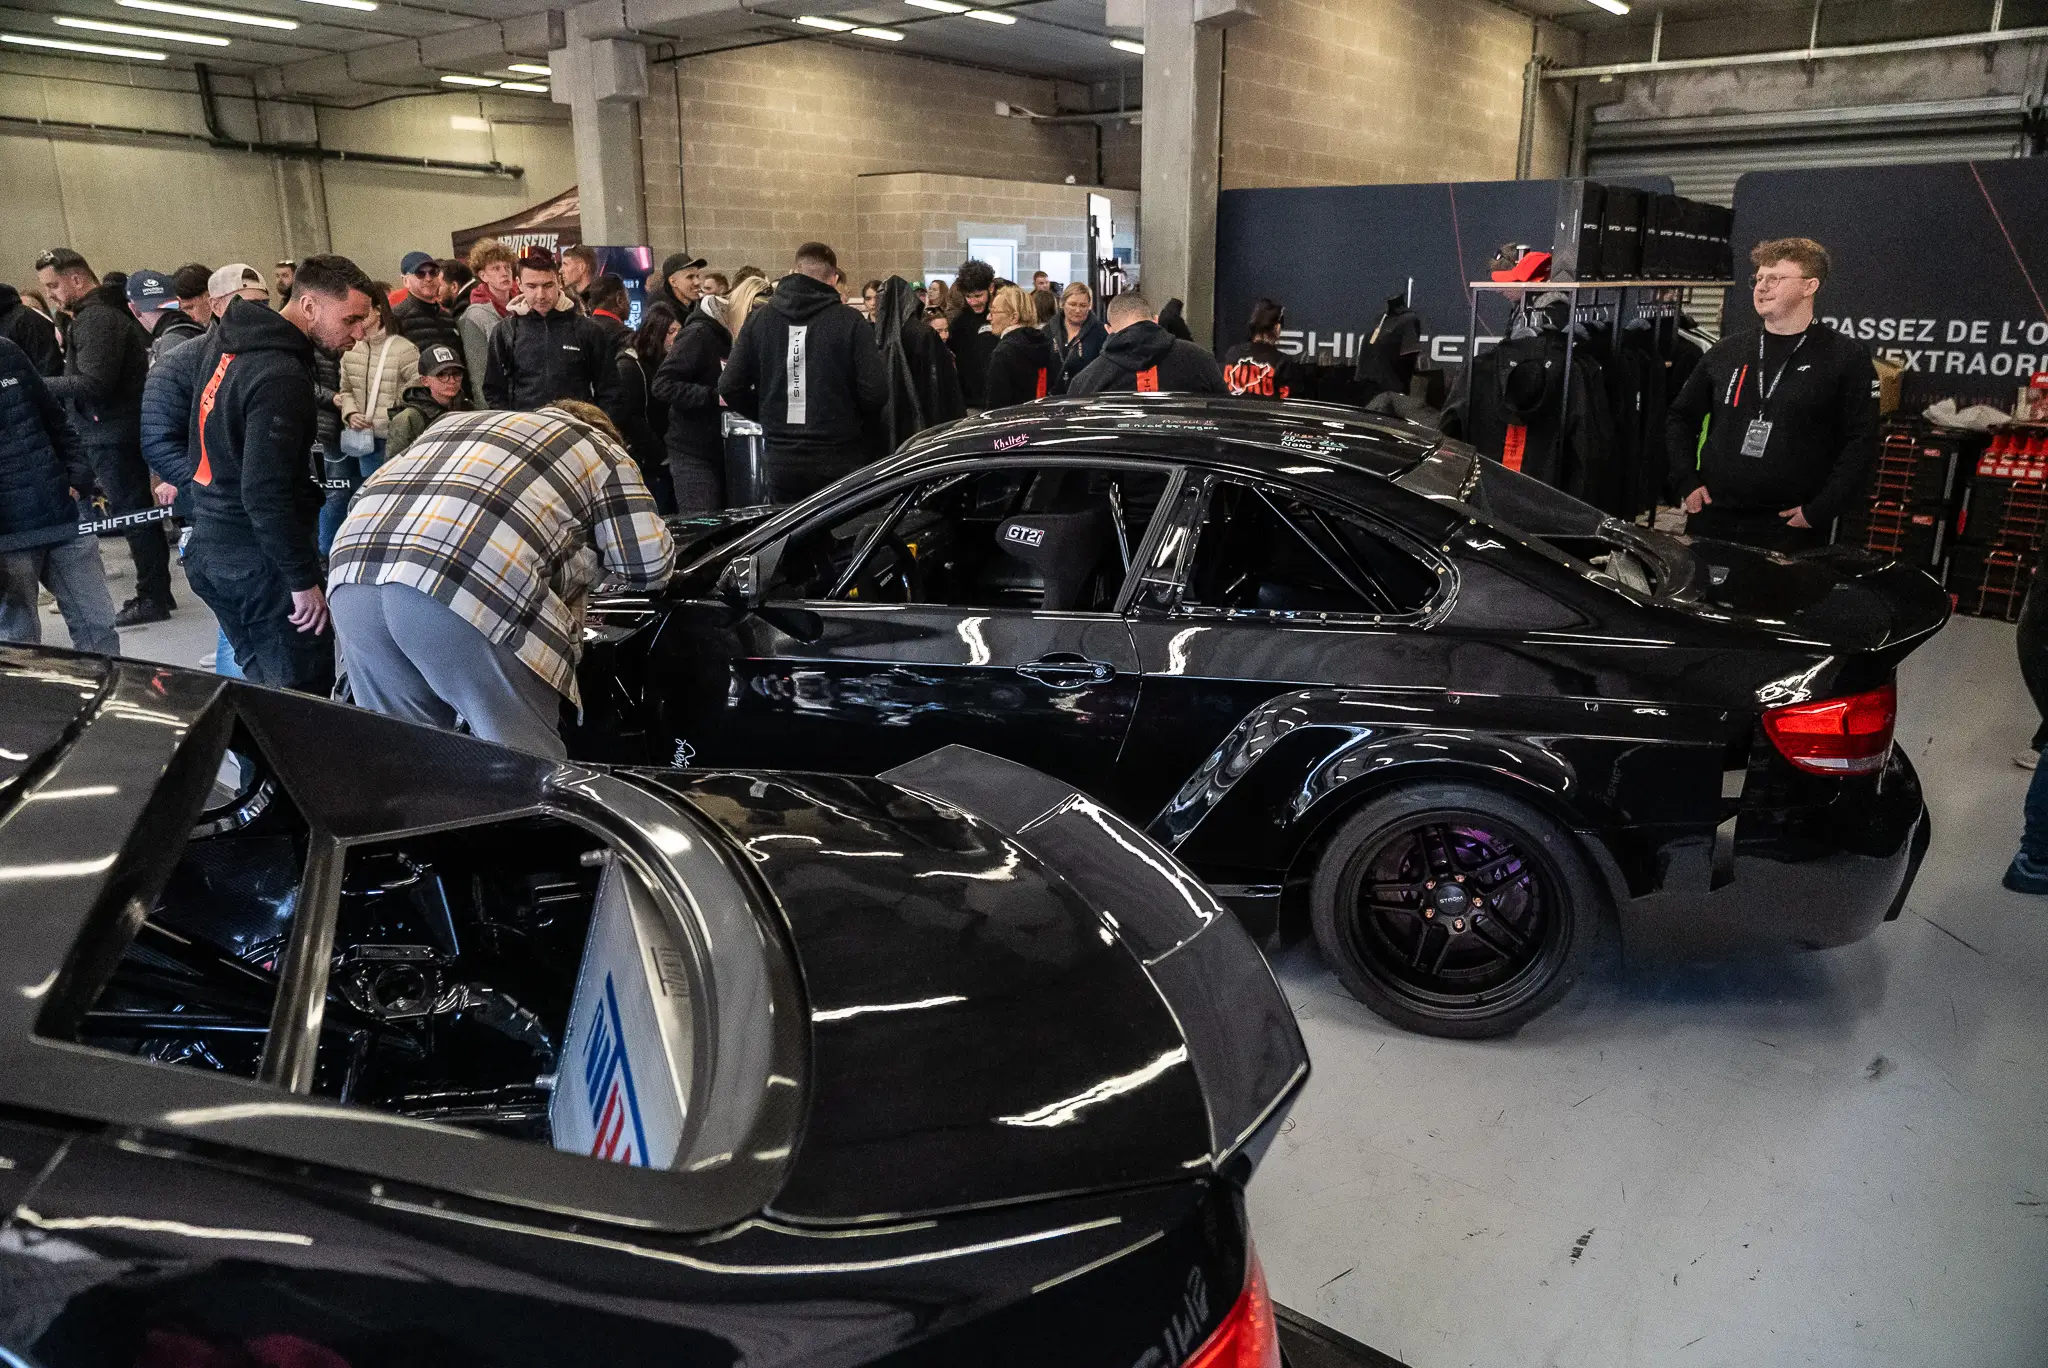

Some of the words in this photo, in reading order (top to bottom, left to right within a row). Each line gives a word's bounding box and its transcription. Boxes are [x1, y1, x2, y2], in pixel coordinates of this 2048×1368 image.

[1946, 319, 1991, 344] DE
[1278, 330, 1504, 363] SHIE
[78, 506, 173, 535] SHIFTECH
[1008, 526, 1044, 545] GT2i
